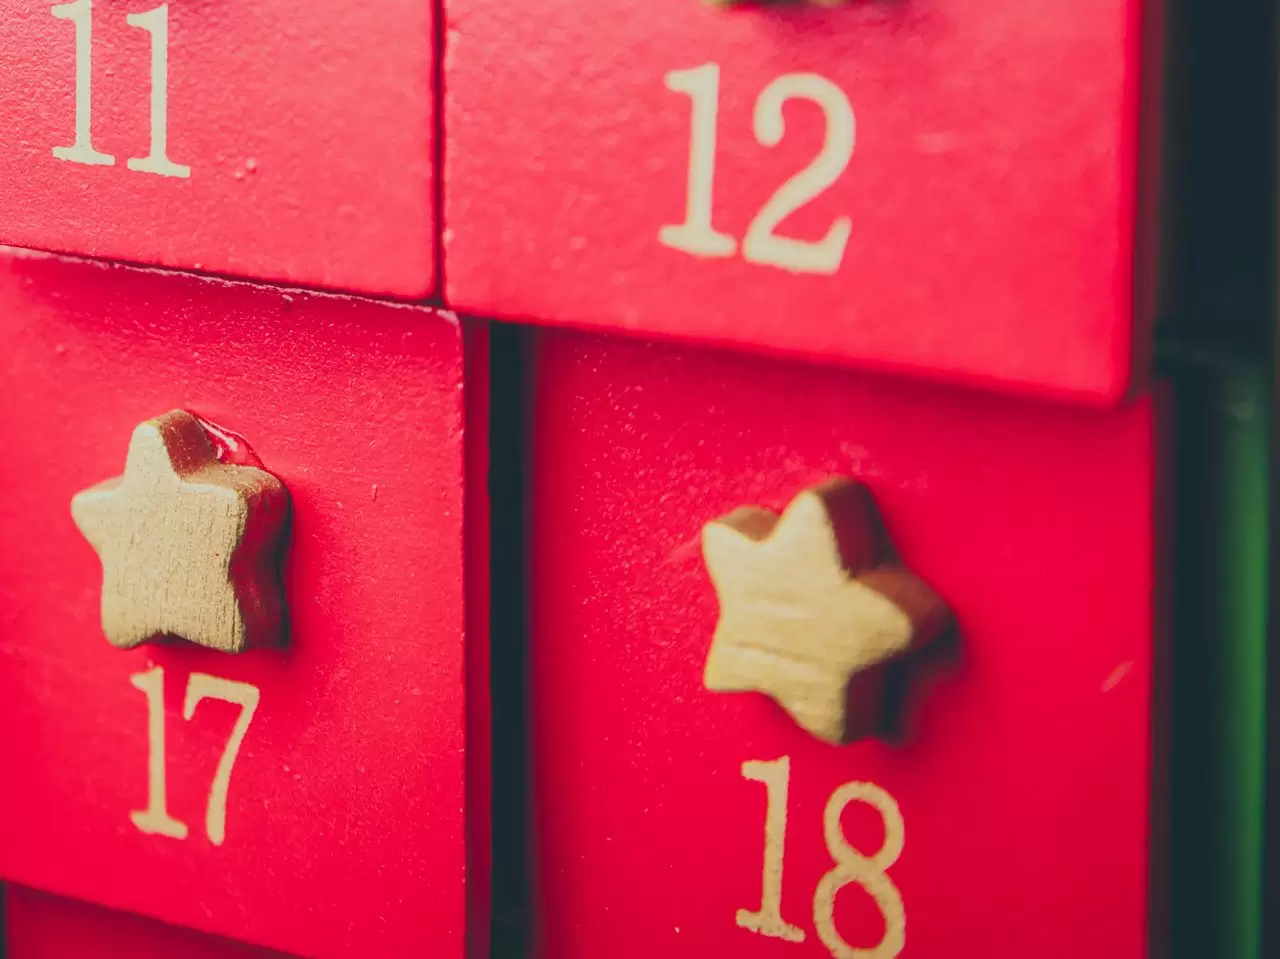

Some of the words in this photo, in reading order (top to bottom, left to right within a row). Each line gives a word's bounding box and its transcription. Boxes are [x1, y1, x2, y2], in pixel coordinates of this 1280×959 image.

[658, 62, 857, 273] 12
[129, 666, 260, 844] 17
[735, 755, 907, 959] 18
